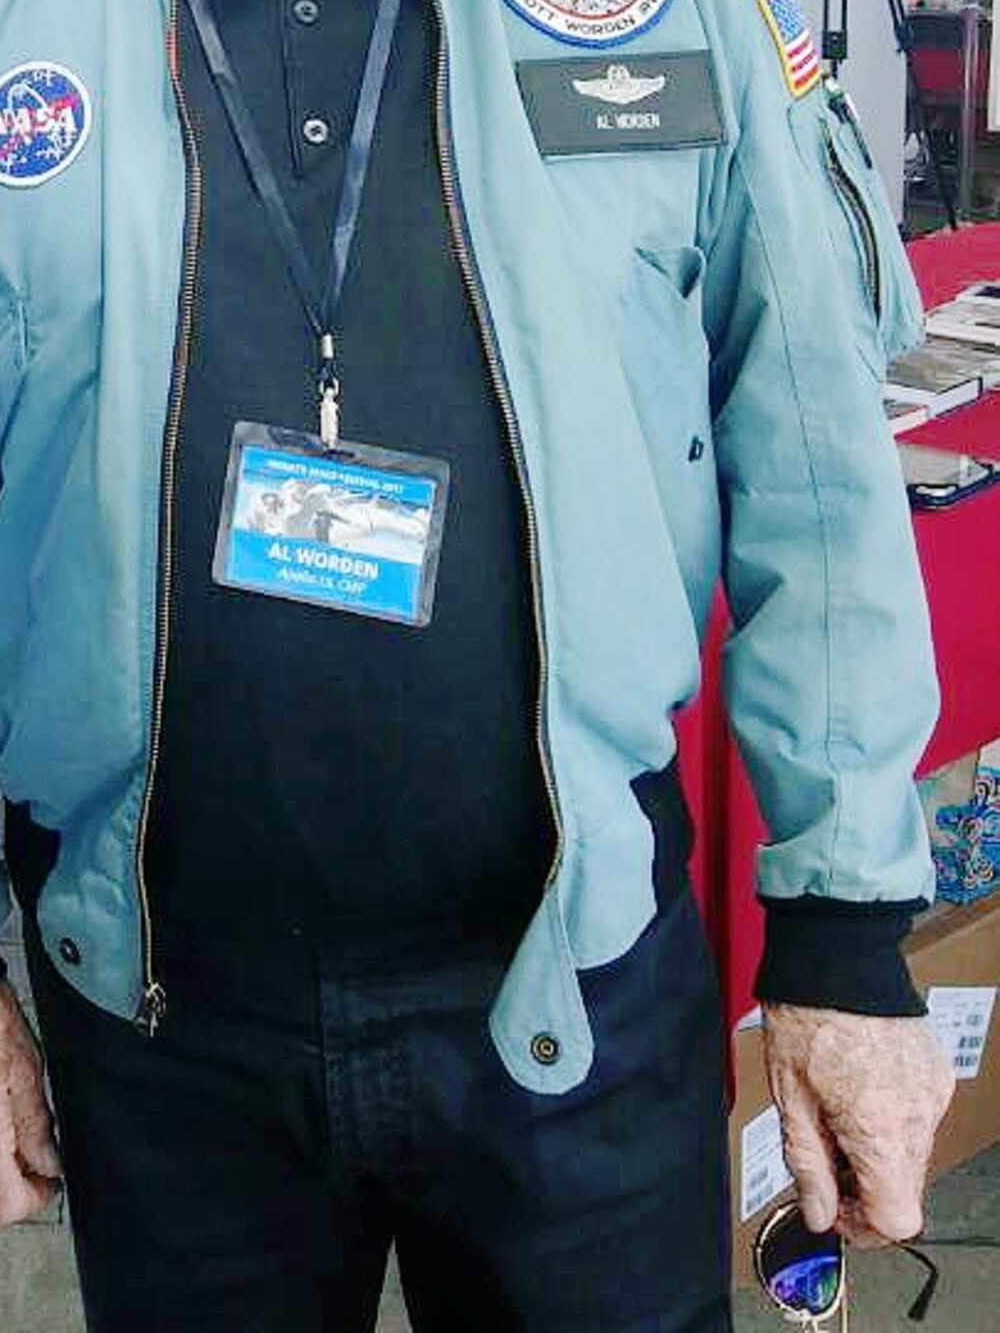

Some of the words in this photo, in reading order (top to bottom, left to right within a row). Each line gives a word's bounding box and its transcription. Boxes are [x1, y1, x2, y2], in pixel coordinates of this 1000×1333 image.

[565, 16, 637, 36] WORDEN
[267, 541, 292, 562] AL
[296, 546, 380, 579] WORDEN
